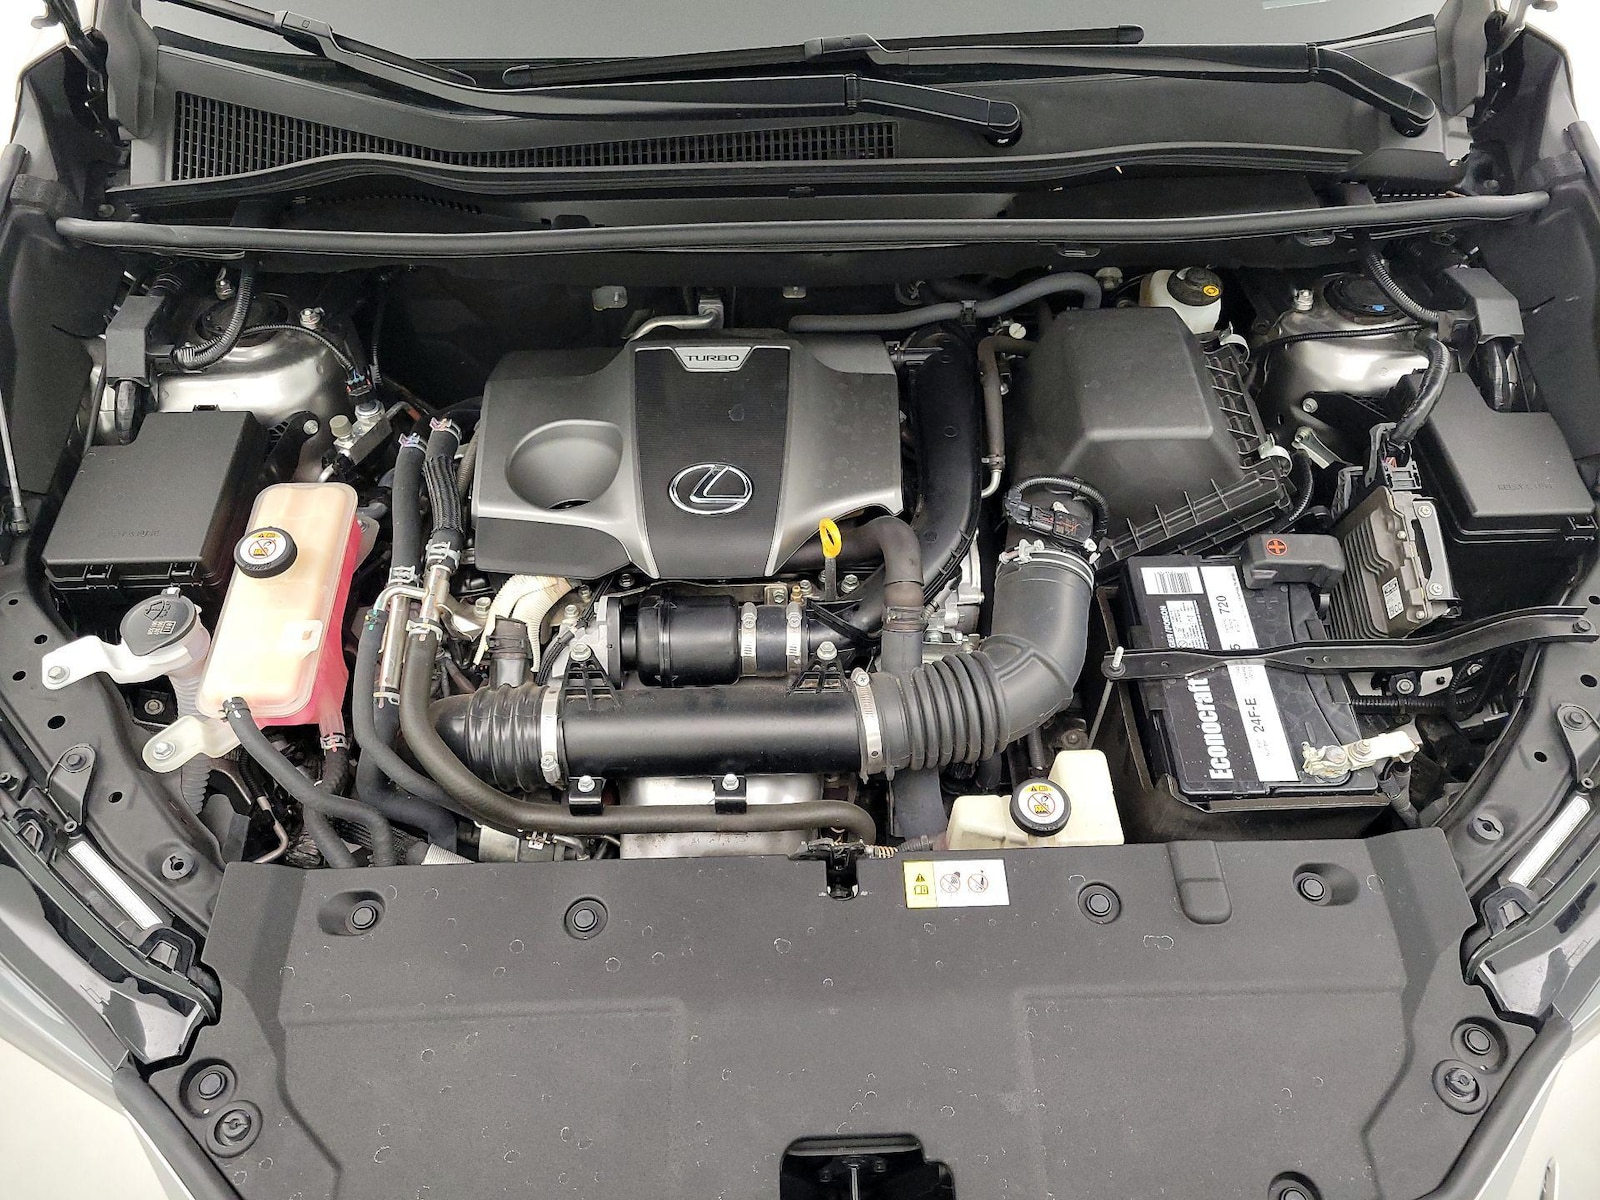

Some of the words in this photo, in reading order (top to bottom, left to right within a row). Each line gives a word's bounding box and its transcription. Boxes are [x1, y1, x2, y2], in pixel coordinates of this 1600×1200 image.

[1216, 595, 1230, 615] 720
[1186, 677, 1235, 780] Econocraft
[1244, 697, 1265, 733] 24F-E
